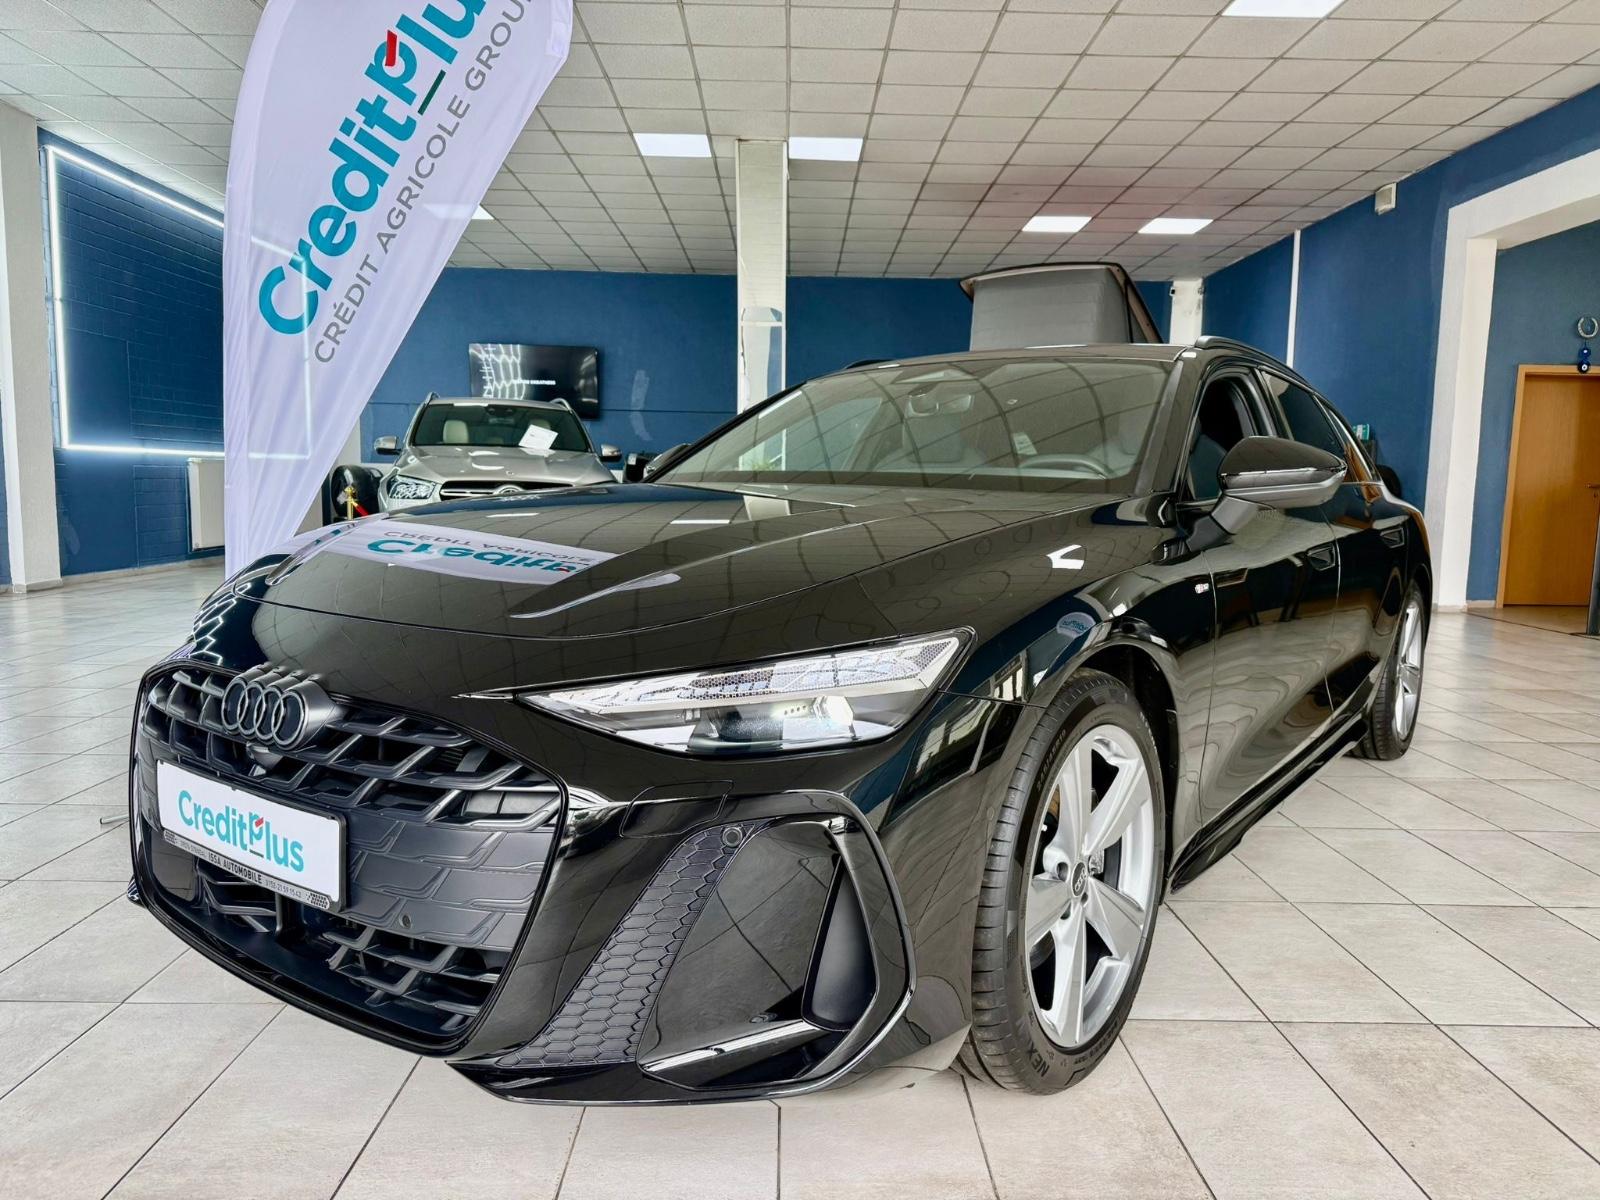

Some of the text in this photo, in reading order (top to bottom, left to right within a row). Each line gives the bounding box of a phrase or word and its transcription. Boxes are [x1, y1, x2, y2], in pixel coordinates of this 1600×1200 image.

[258, 0, 488, 335] Creditplu
[315, 0, 531, 363] CRÉDIT AGRICOLE GROU
[208, 851, 221, 865] ISSA
[223, 858, 262, 884] AUTOMOBILE
